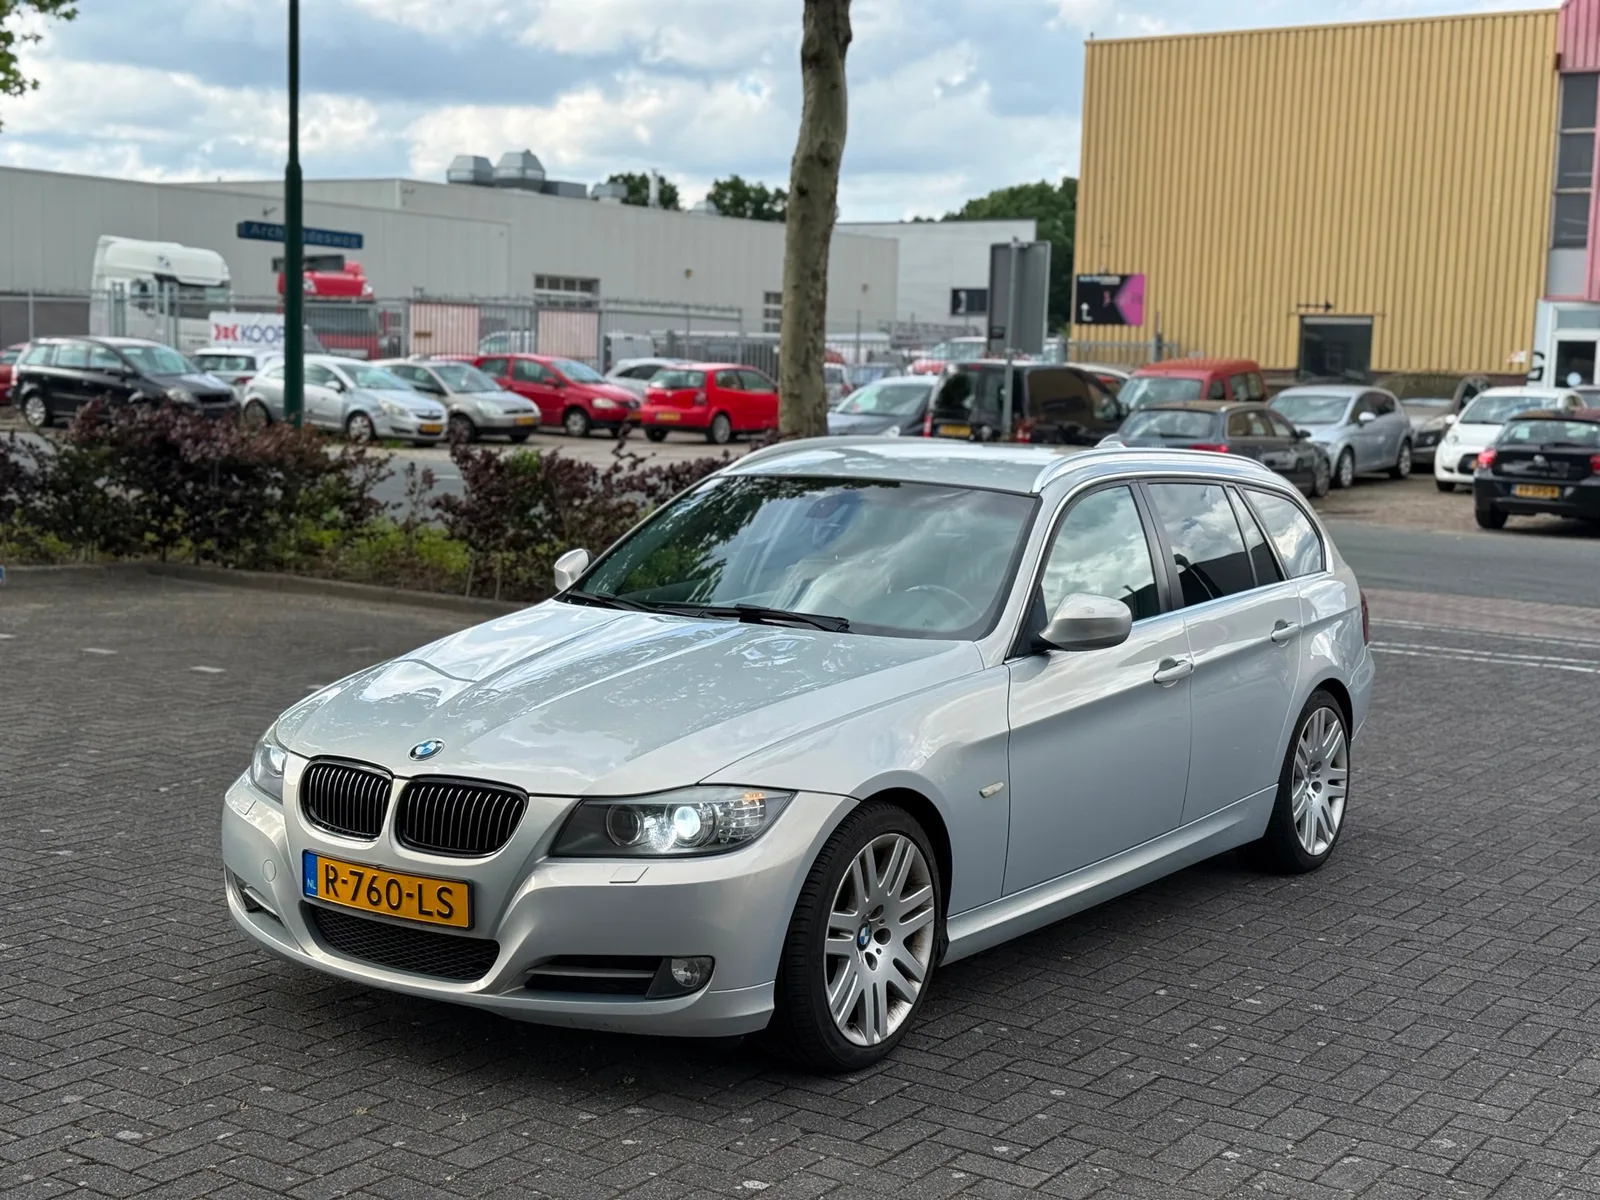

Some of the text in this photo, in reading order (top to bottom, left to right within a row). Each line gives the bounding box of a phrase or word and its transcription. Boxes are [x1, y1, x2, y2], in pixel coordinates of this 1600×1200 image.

[250, 224, 359, 249] Archdesweg
[307, 878, 316, 890] NL
[325, 863, 453, 919] R-760-LS
